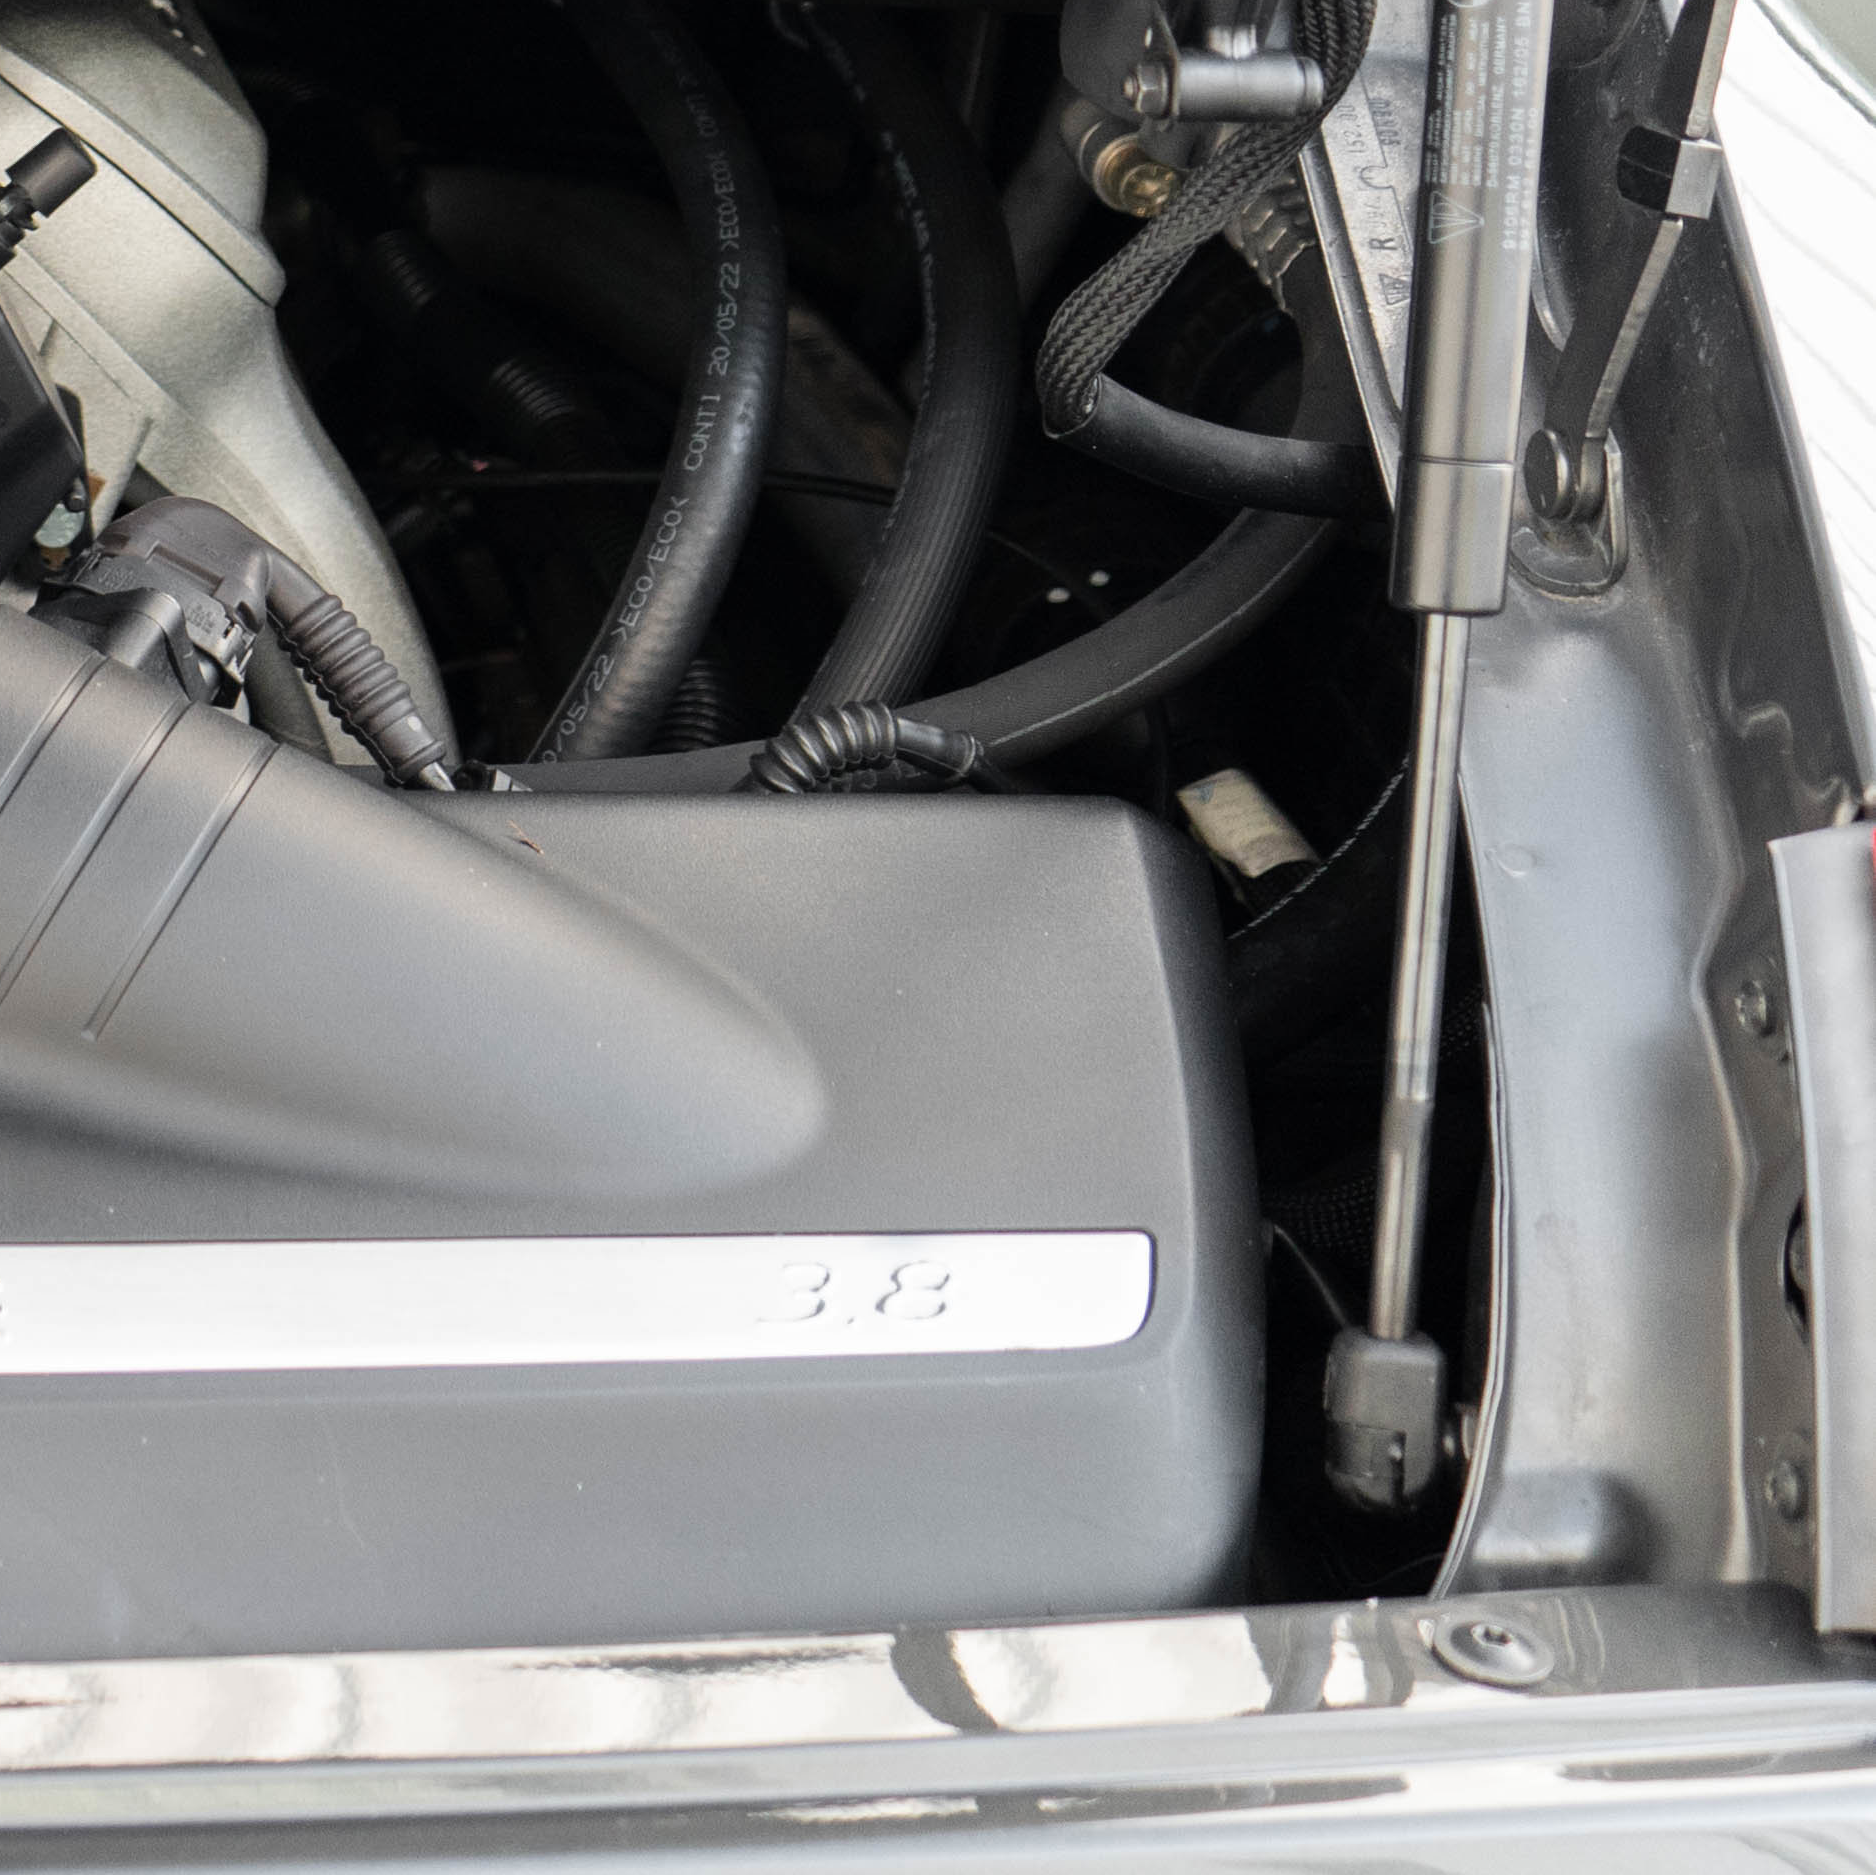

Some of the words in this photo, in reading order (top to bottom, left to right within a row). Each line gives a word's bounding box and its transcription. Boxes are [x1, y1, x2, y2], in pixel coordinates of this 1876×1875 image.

[542, 654, 614, 765] 0/05/22
[708, 262, 740, 377] 20/05/22
[755, 1258, 953, 1325] 3.8
